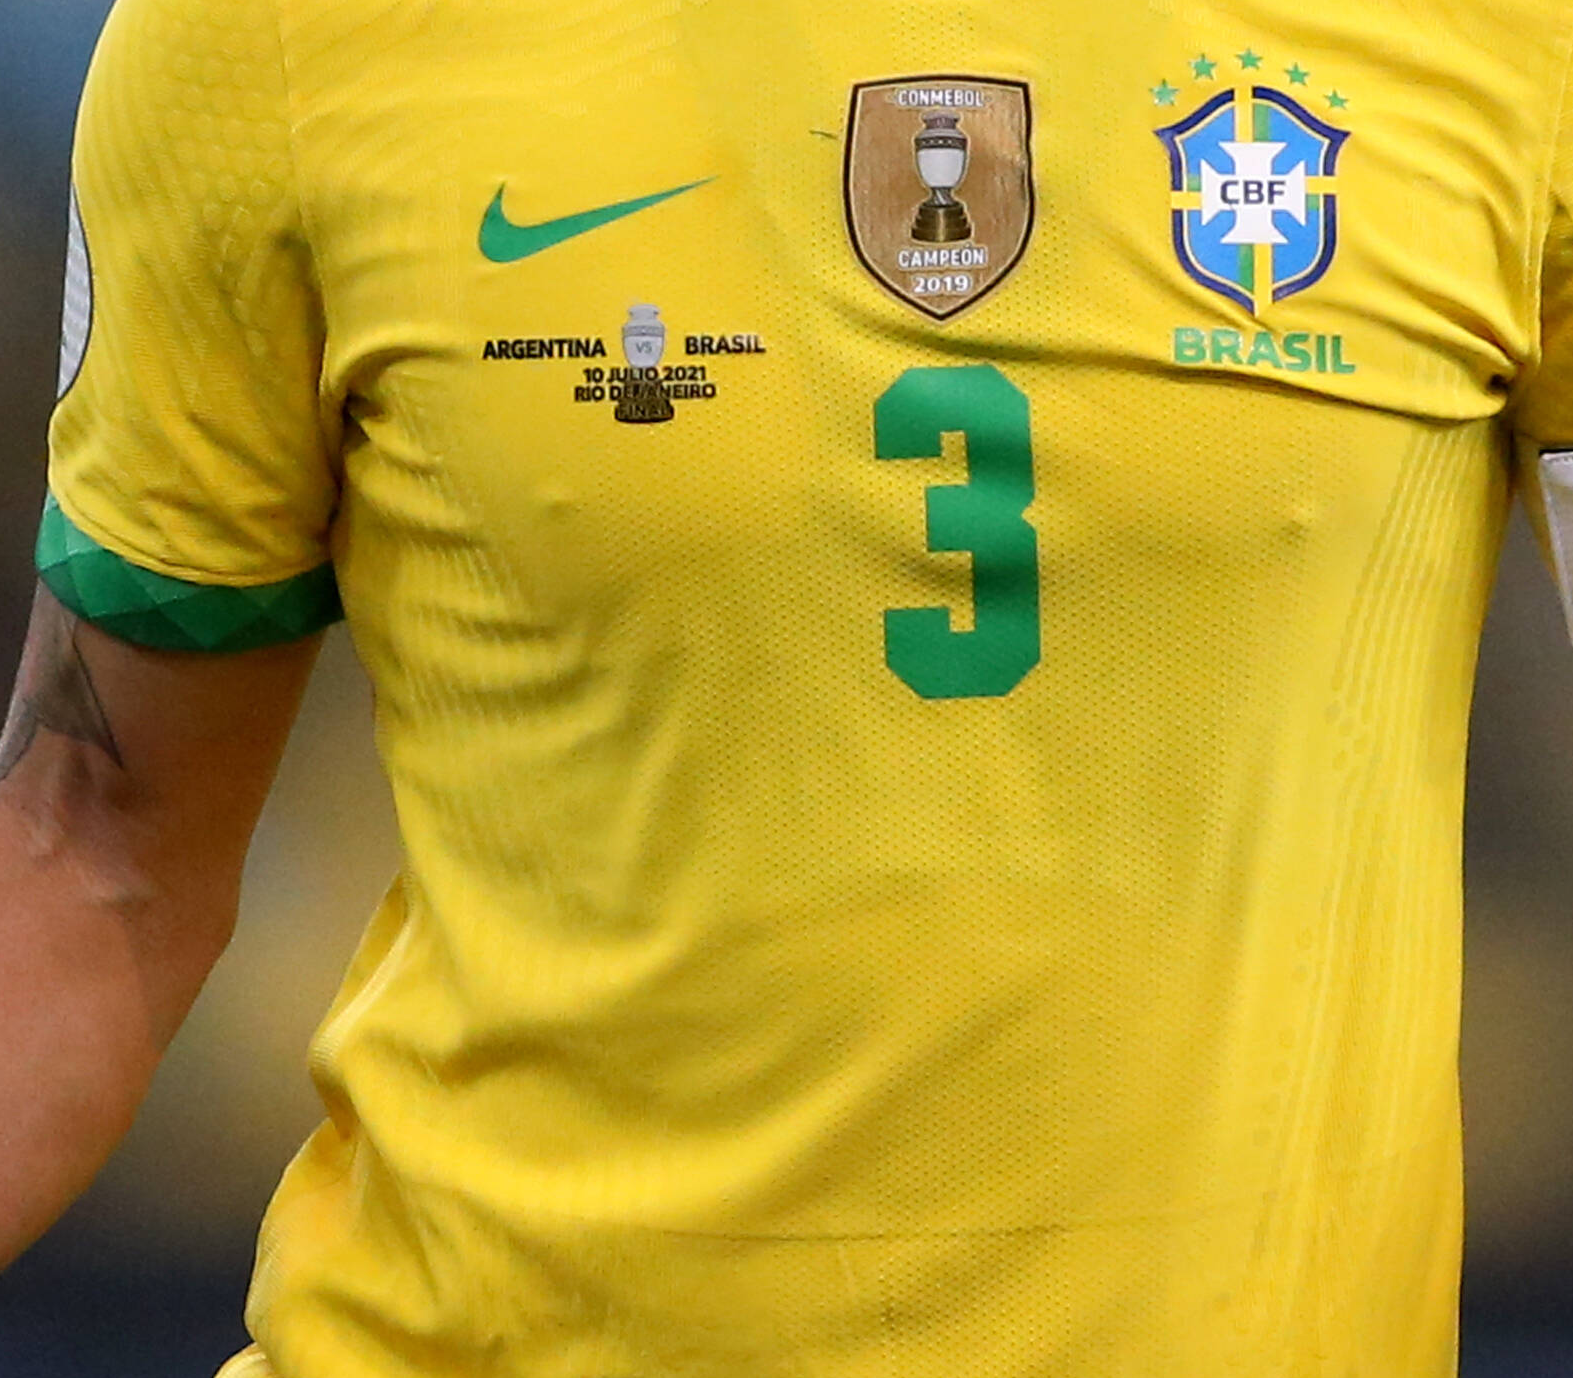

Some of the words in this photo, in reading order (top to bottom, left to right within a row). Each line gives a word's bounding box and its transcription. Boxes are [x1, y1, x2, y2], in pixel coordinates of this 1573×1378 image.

[897, 89, 984, 107] CONMEBOL
[1219, 180, 1286, 205] CBF
[898, 242, 985, 268] CAMPEÓN
[913, 274, 970, 293] 2019
[482, 337, 607, 360] ARGENTINA
[635, 341, 653, 355] VS
[684, 333, 766, 356] BRASIL
[1173, 327, 1356, 374] BRASIL
[582, 367, 604, 383] 10
[607, 366, 659, 383] JULIO
[662, 365, 707, 382] 2021
[574, 385, 606, 402] RIO
[872, 364, 1041, 700] 3
